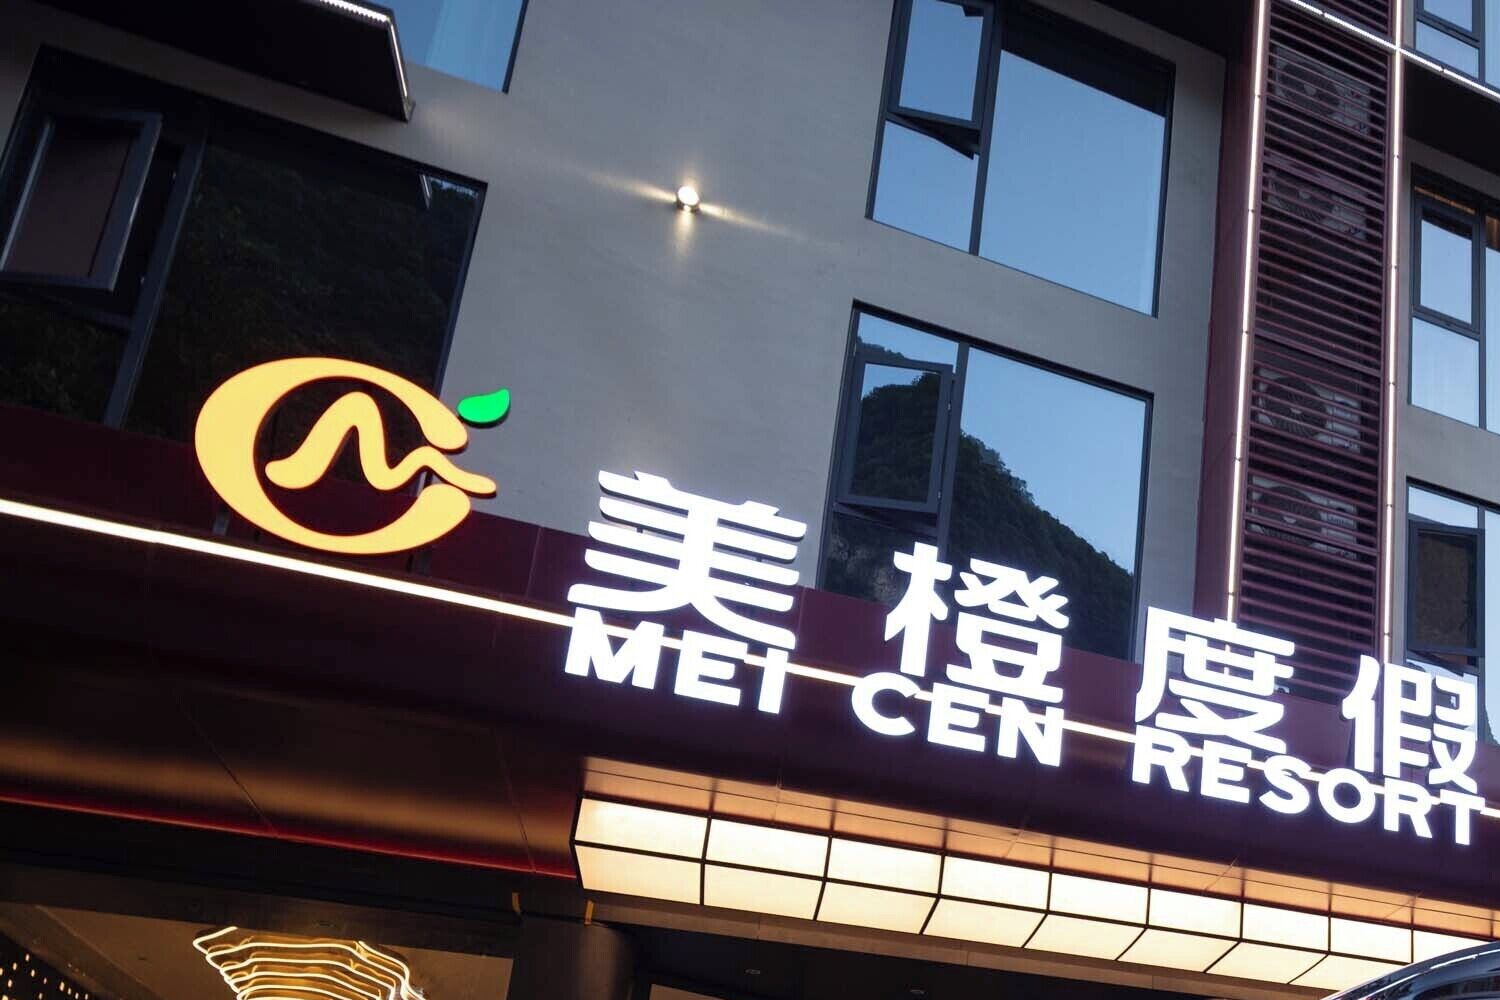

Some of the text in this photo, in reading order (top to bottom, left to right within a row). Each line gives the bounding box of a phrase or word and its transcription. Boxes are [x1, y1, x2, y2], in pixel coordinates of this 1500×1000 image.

[564, 606, 789, 715] MEI
[851, 671, 1065, 767] CEN
[1131, 724, 1486, 846] RESORT
